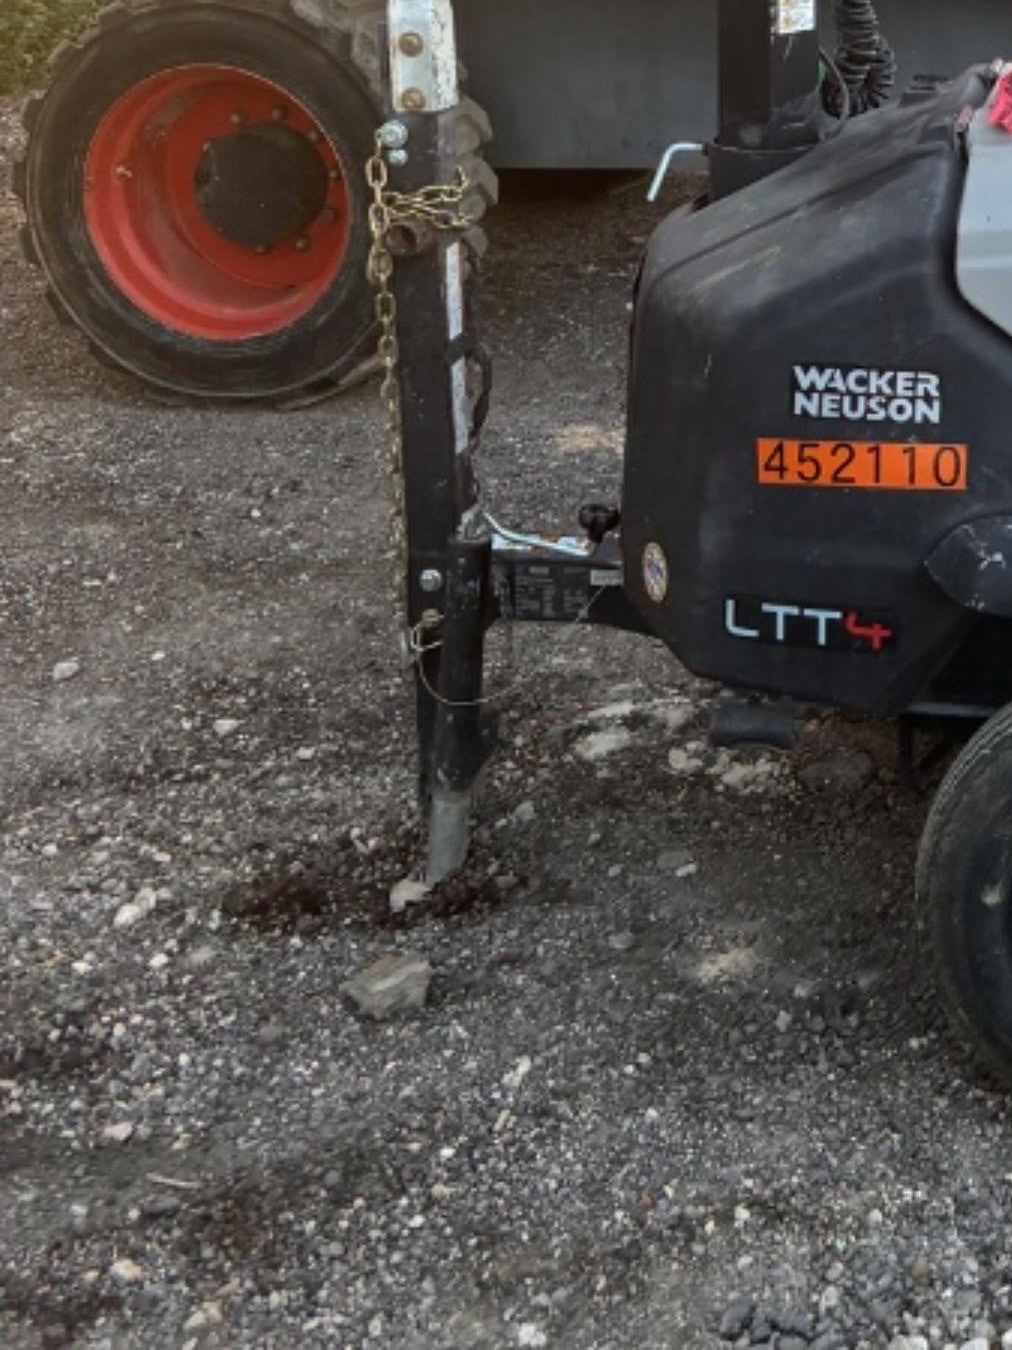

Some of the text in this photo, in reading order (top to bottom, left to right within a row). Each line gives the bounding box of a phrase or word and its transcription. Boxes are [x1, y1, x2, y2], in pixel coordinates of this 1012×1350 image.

[791, 364, 941, 398] WACKER
[793, 392, 942, 424] NEUSON
[763, 440, 962, 488] 452110
[724, 598, 893, 652] LTT4
